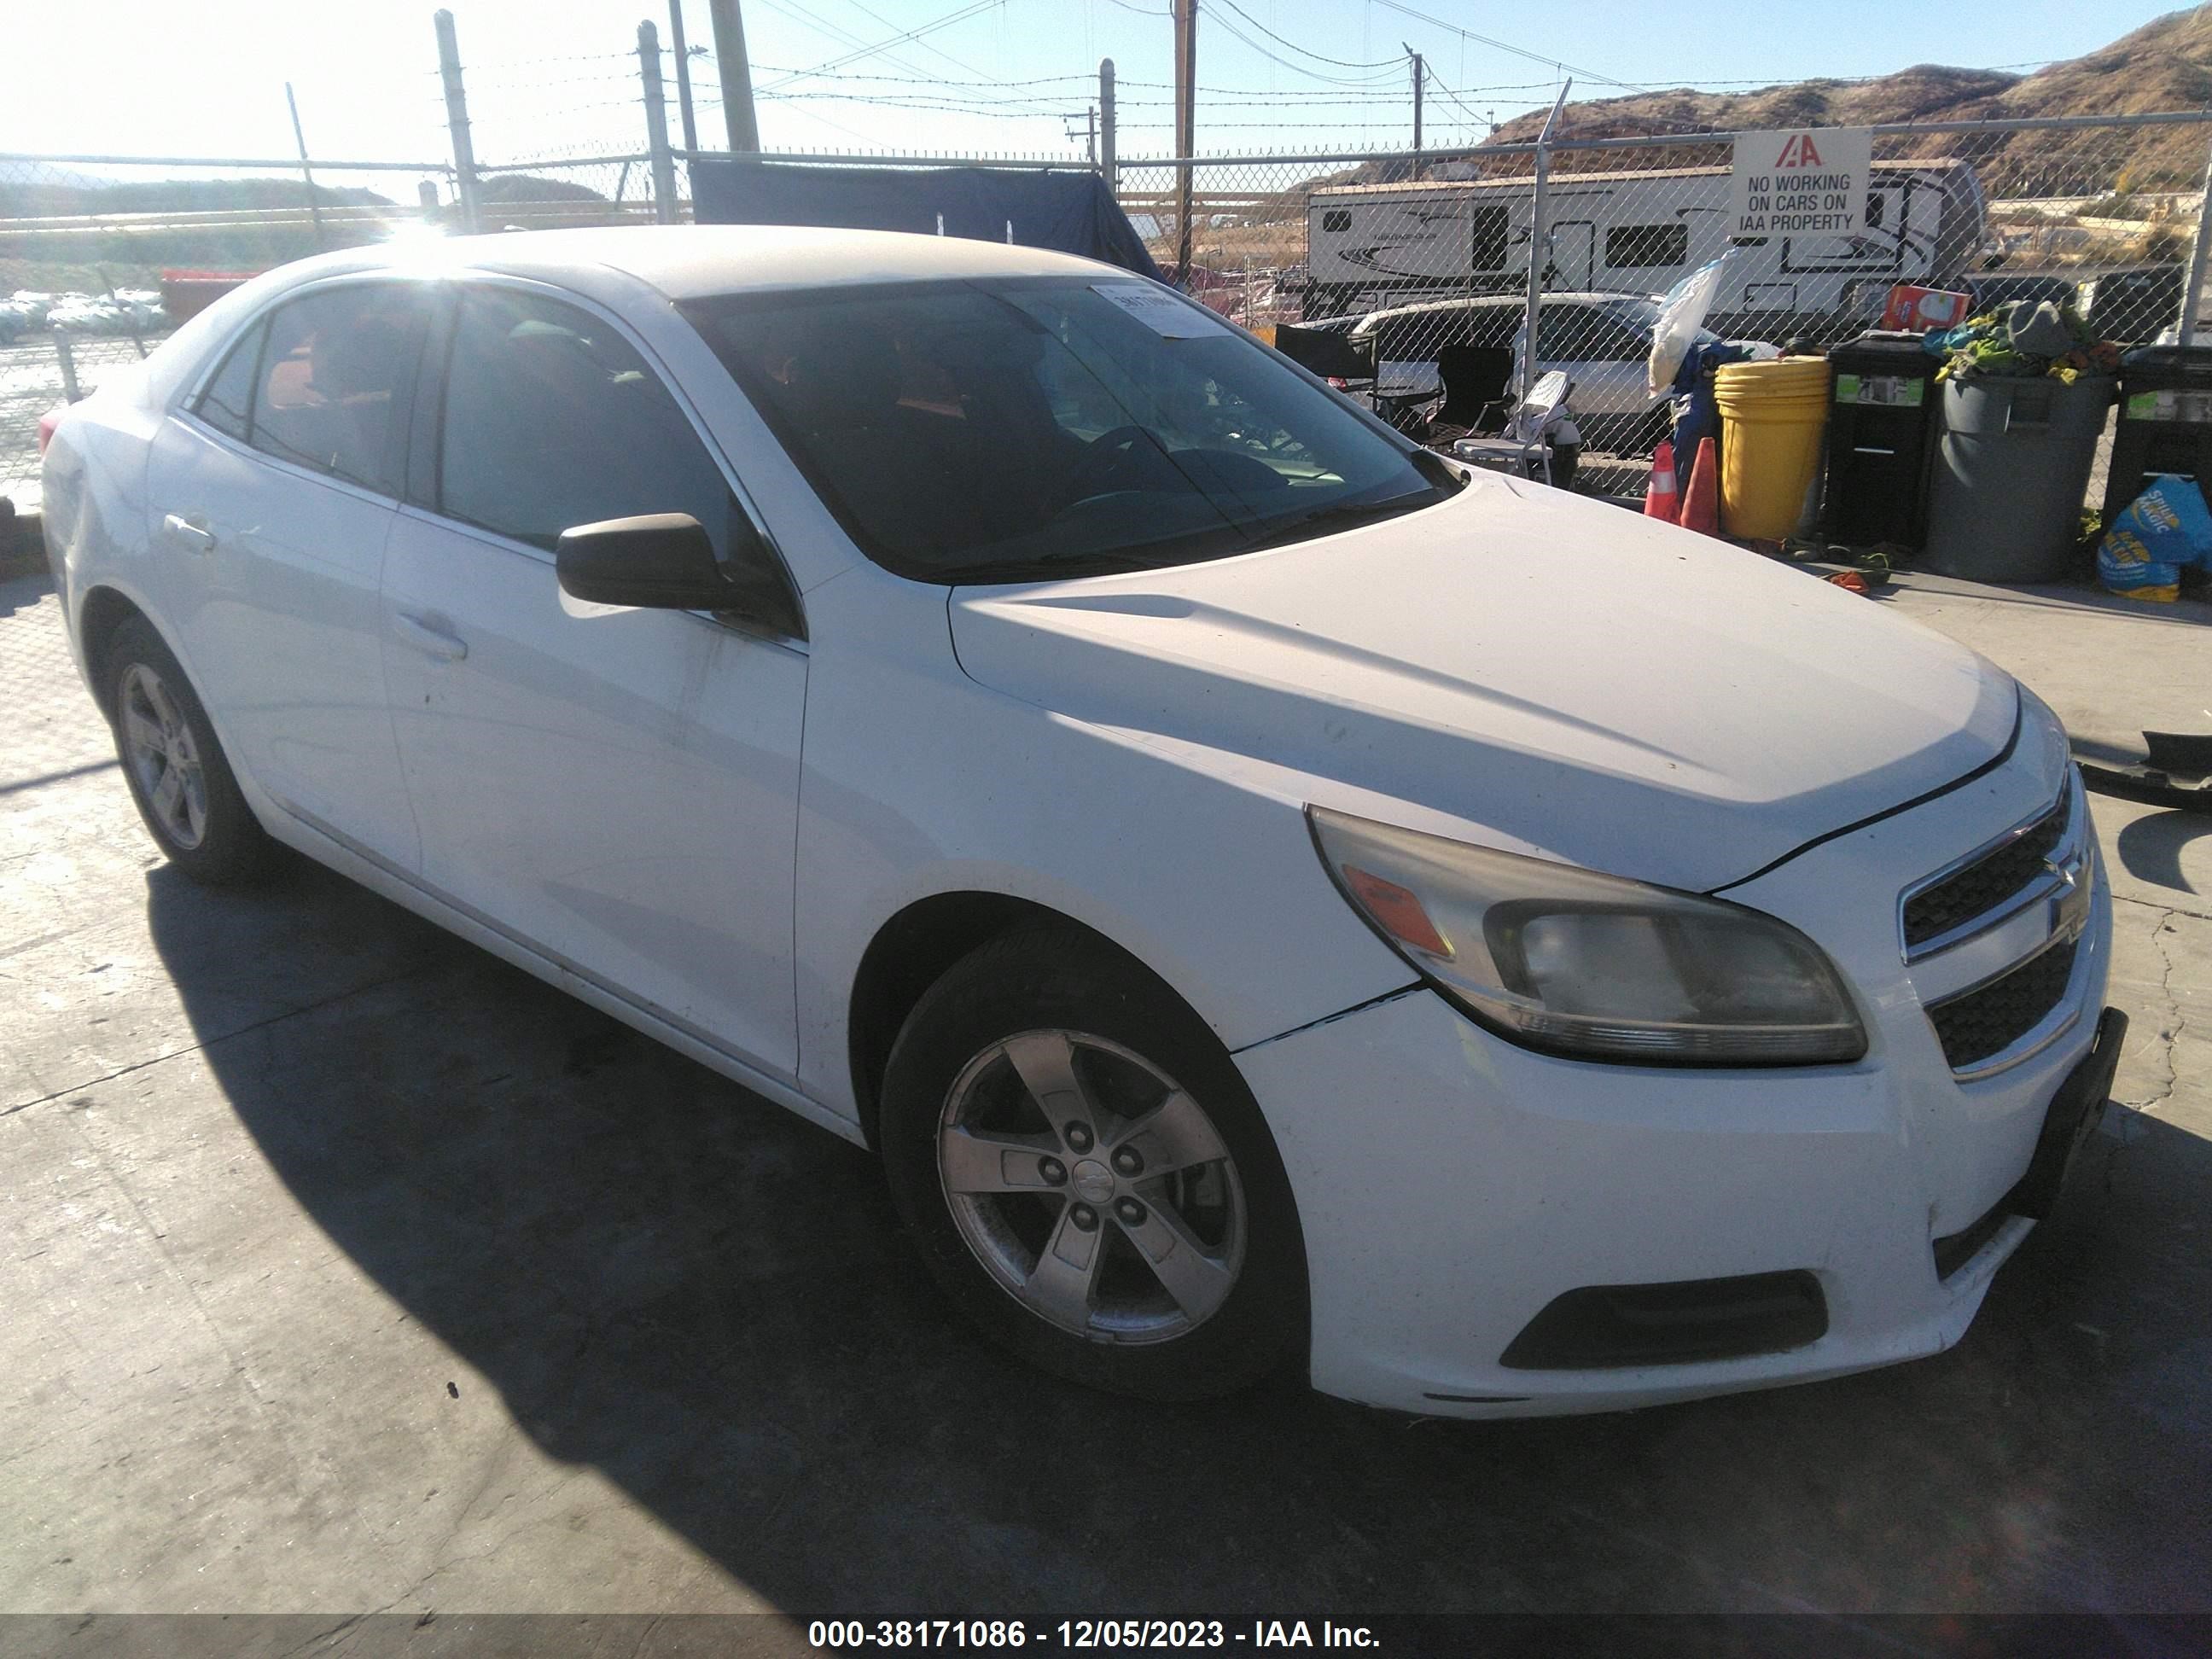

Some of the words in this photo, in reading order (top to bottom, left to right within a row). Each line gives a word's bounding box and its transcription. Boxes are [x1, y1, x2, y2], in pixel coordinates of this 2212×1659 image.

[1749, 177, 1770, 192] NO
[1776, 174, 1850, 191] WORKING
[1749, 196, 1770, 212] ON
[1776, 195, 1818, 211] CARS
[1824, 195, 1847, 210] ON
[1739, 216, 1765, 230] IAA
[1771, 214, 1854, 230] PROPERTY
